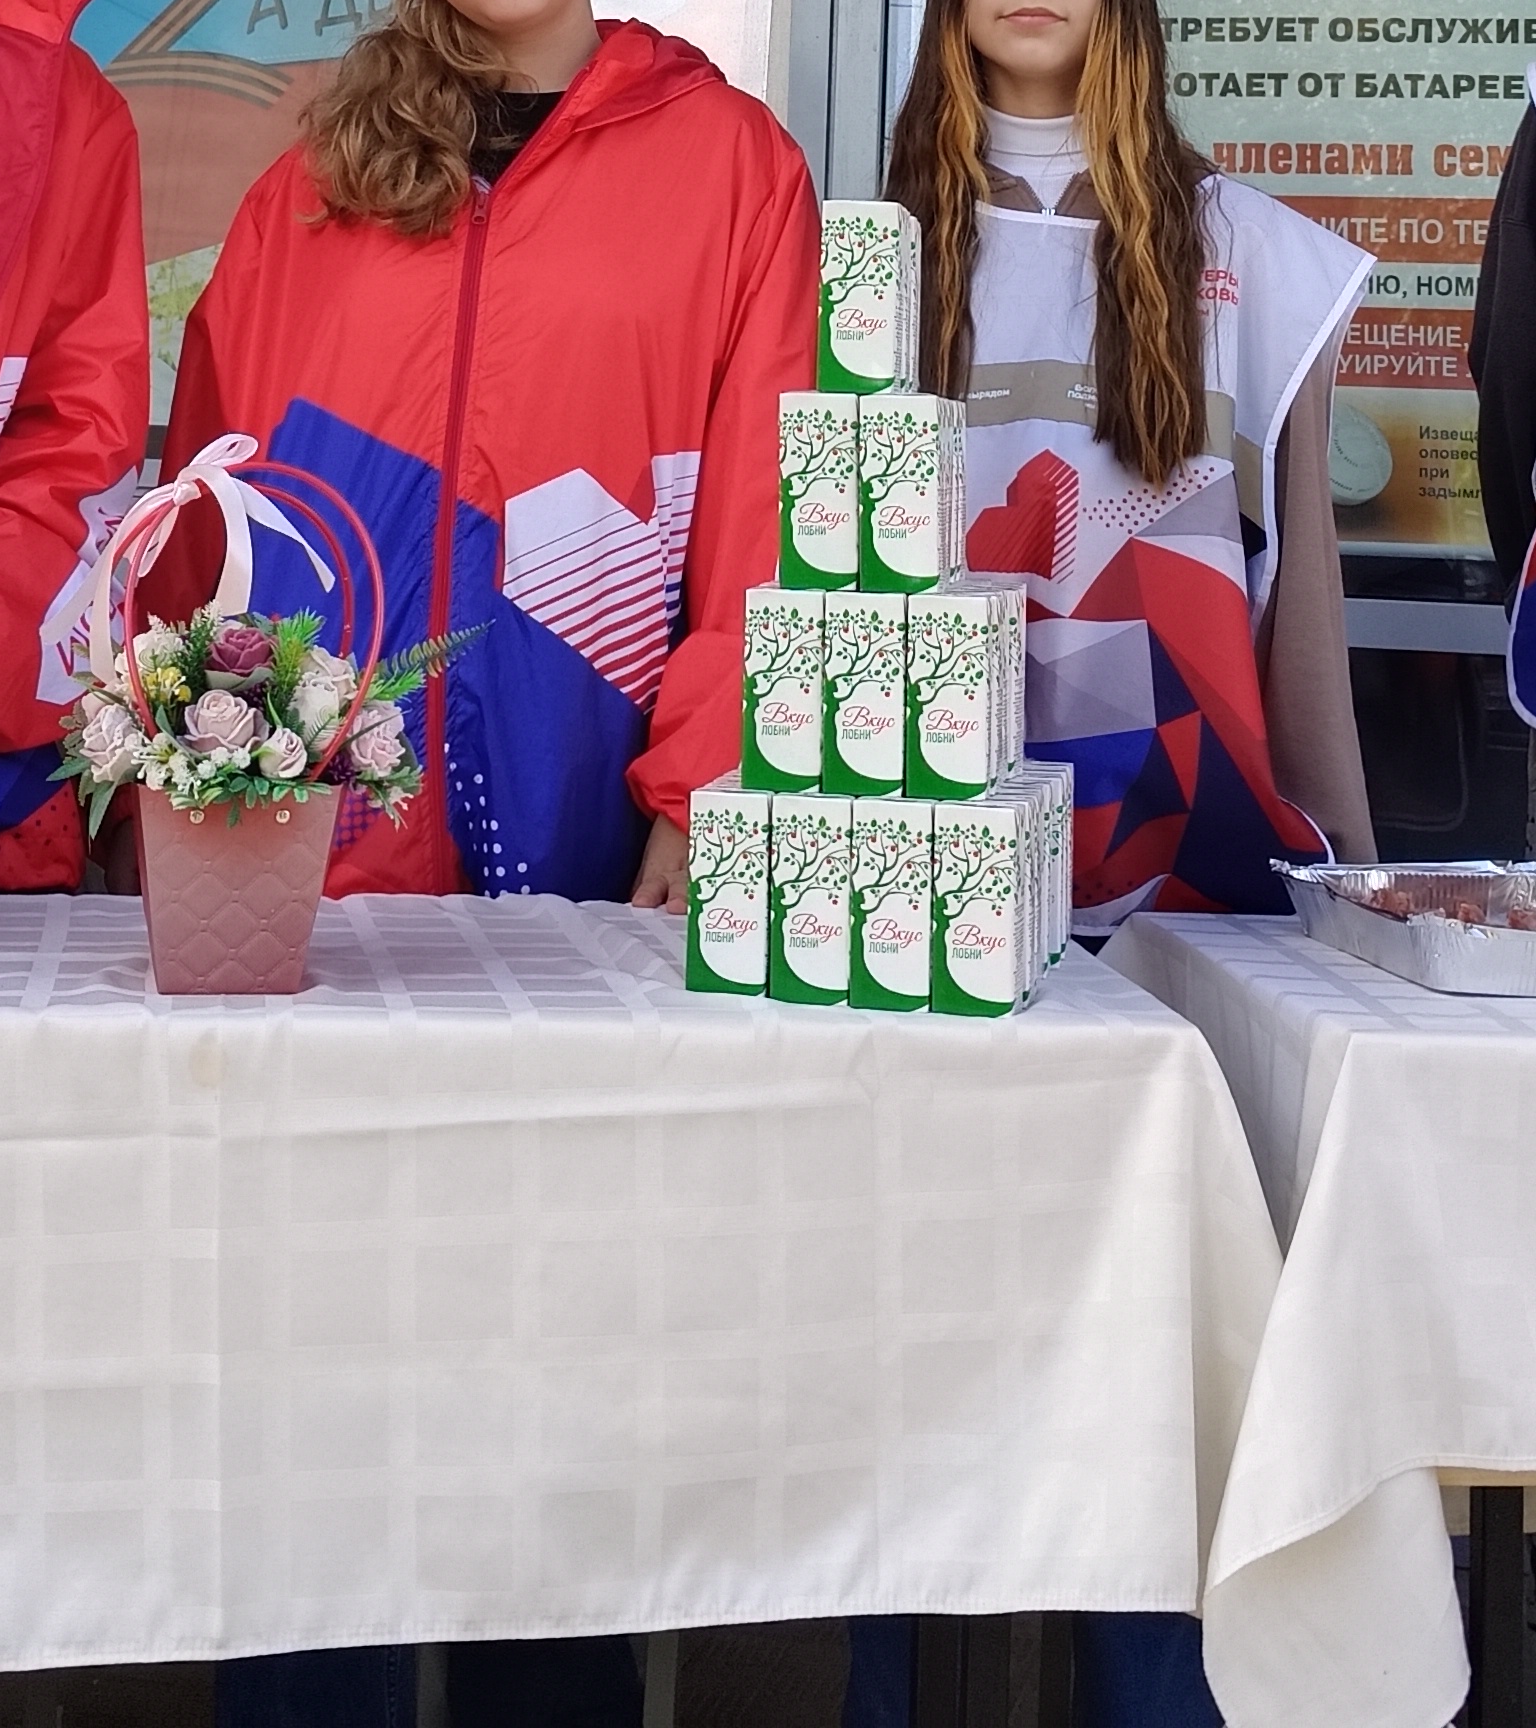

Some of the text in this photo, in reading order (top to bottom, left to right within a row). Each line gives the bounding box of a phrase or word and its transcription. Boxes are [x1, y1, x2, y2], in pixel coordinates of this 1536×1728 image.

[1160, 17, 1319, 43] ТРЕБУЕТ
[1298, 73, 1347, 99] ОТ
[1355, 73, 1525, 100] БАТАРЕЕ
[1213, 142, 1414, 176] членами
[1399, 219, 1444, 244] ПО
[1417, 276, 1476, 297] НОМ
[837, 309, 887, 336] Вкус
[837, 330, 863, 340] ЛОБНИ
[1346, 324, 1469, 351] ЕЩЕНИЕ,
[1419, 467, 1450, 481] при
[798, 504, 850, 531] Вкус
[798, 525, 826, 535] ЛОБНИ
[879, 506, 931, 533] Вкус
[879, 528, 906, 538] ЛОБНИ
[762, 704, 813, 730] Вкус
[762, 725, 790, 735] ЛОБНИ
[842, 706, 895, 736] Вкус
[926, 710, 979, 738] Вкус
[842, 730, 870, 739] ЛОБНИ
[926, 732, 954, 743] ЛОБНИ
[706, 909, 757, 938] Вкус
[790, 914, 842, 944] Вкус
[870, 918, 923, 949] Вкус
[705, 931, 734, 943] ЛОБНИ
[790, 937, 818, 948] ЛОБНИ
[869, 942, 898, 953] ЛОБНИ
[953, 925, 1006, 954] Вкус
[952, 948, 981, 959] ЛОБНИ
